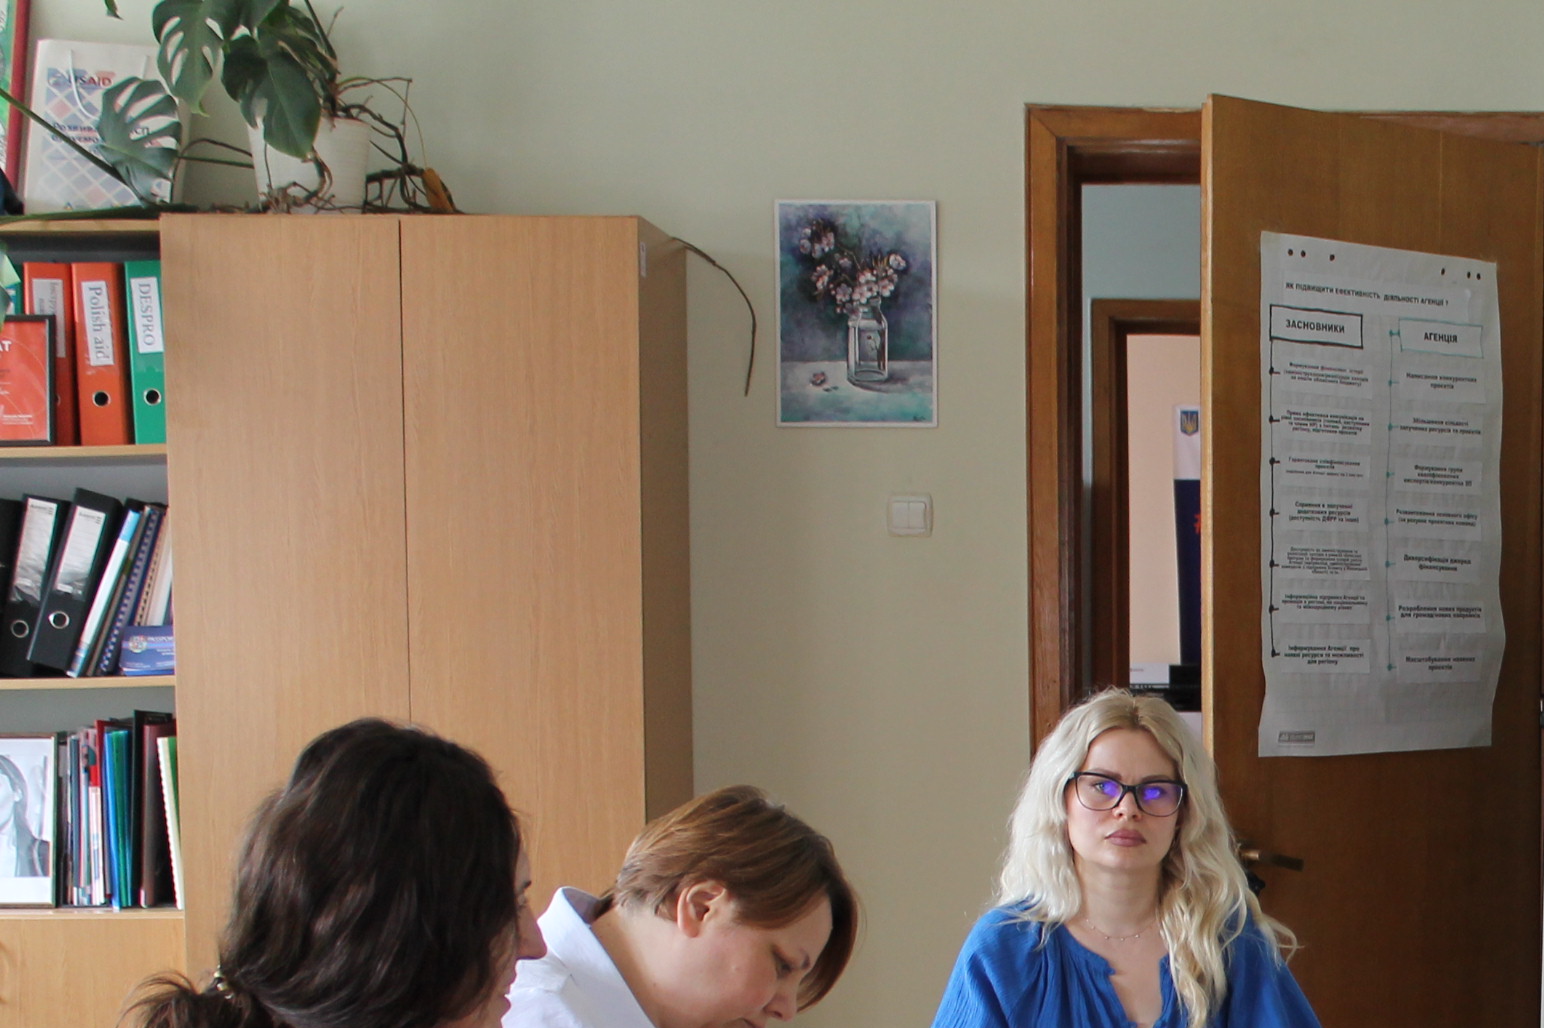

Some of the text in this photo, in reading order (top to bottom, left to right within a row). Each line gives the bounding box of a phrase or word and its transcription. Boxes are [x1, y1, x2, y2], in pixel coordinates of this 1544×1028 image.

[1335, 287, 1381, 300] ЕФЕКТИВНІСТЬ
[138, 282, 156, 347] DESPRO
[88, 286, 110, 361] Polish aid
[1285, 318, 1345, 334] ЗАСНОВНИКИ
[1423, 331, 1458, 344] АГЕНЦІЯ
